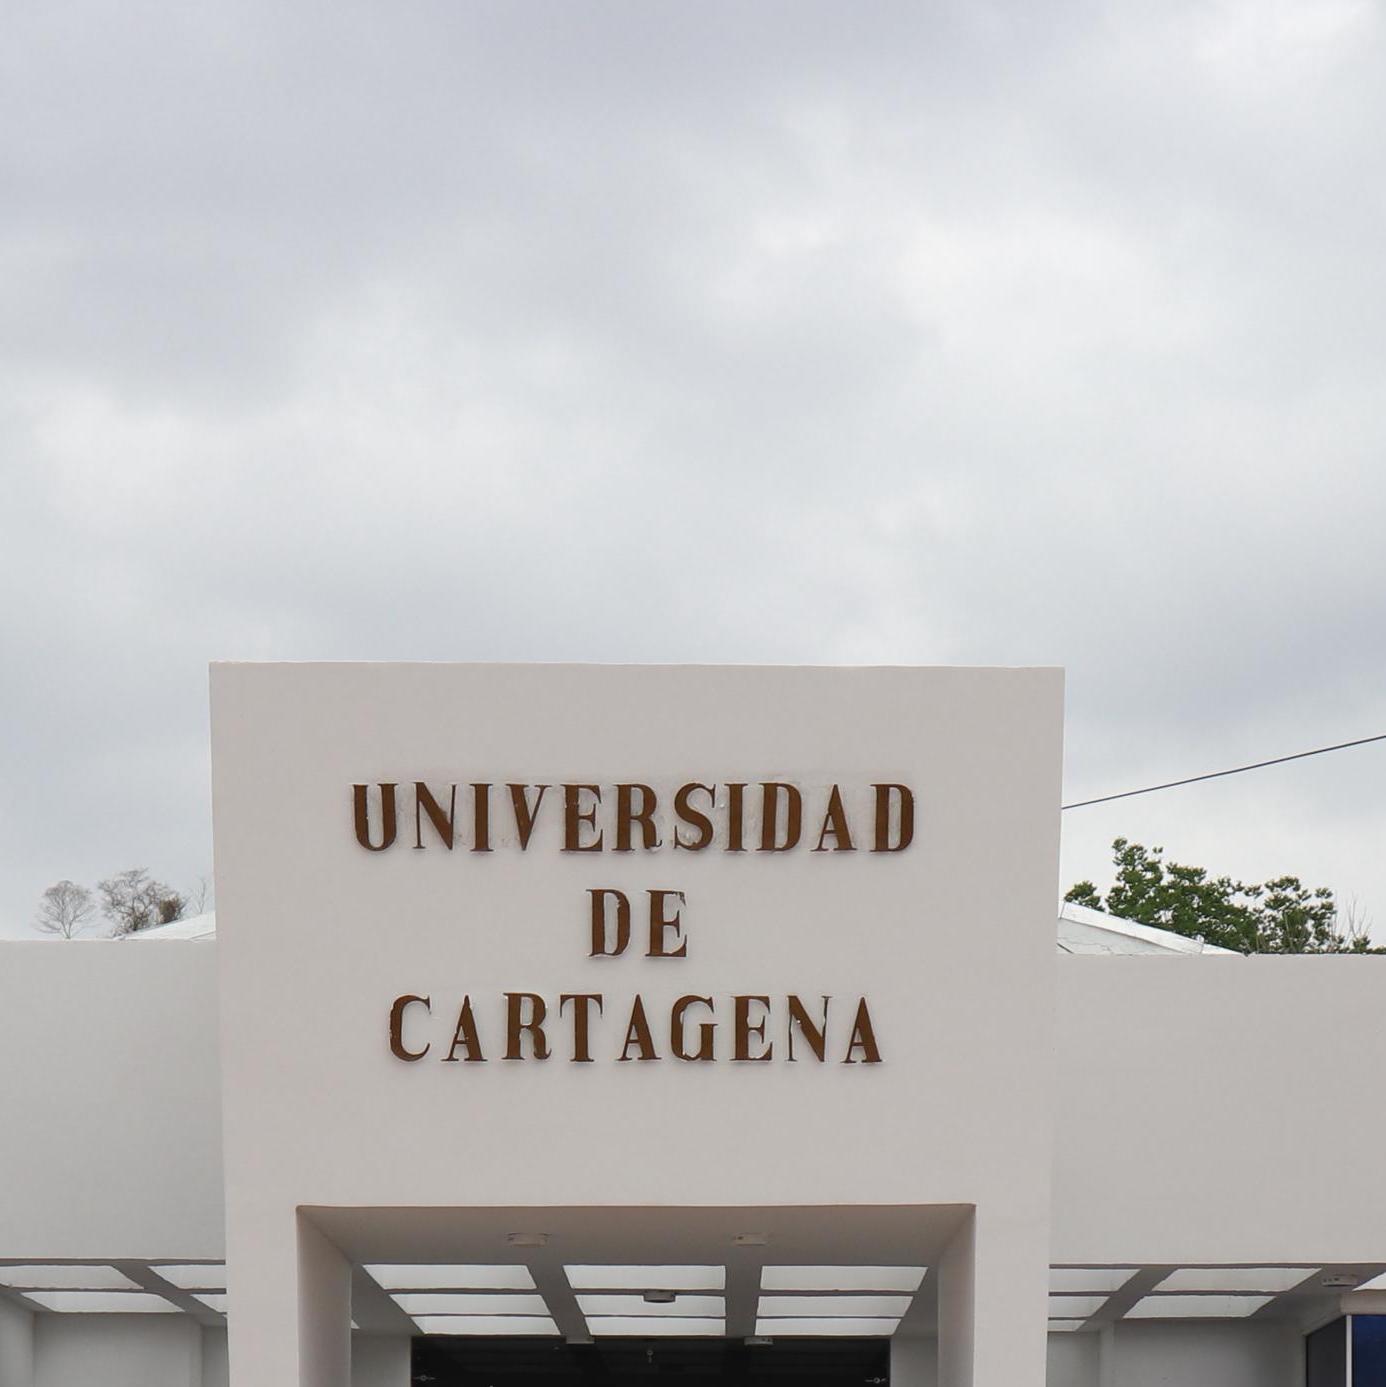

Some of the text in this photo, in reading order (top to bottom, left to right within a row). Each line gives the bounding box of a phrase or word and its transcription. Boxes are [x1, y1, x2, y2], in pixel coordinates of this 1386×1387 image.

[353, 782, 914, 854] UNIVERSIDAD
[586, 889, 687, 958] DE
[389, 993, 882, 1065] CARTAGENA
